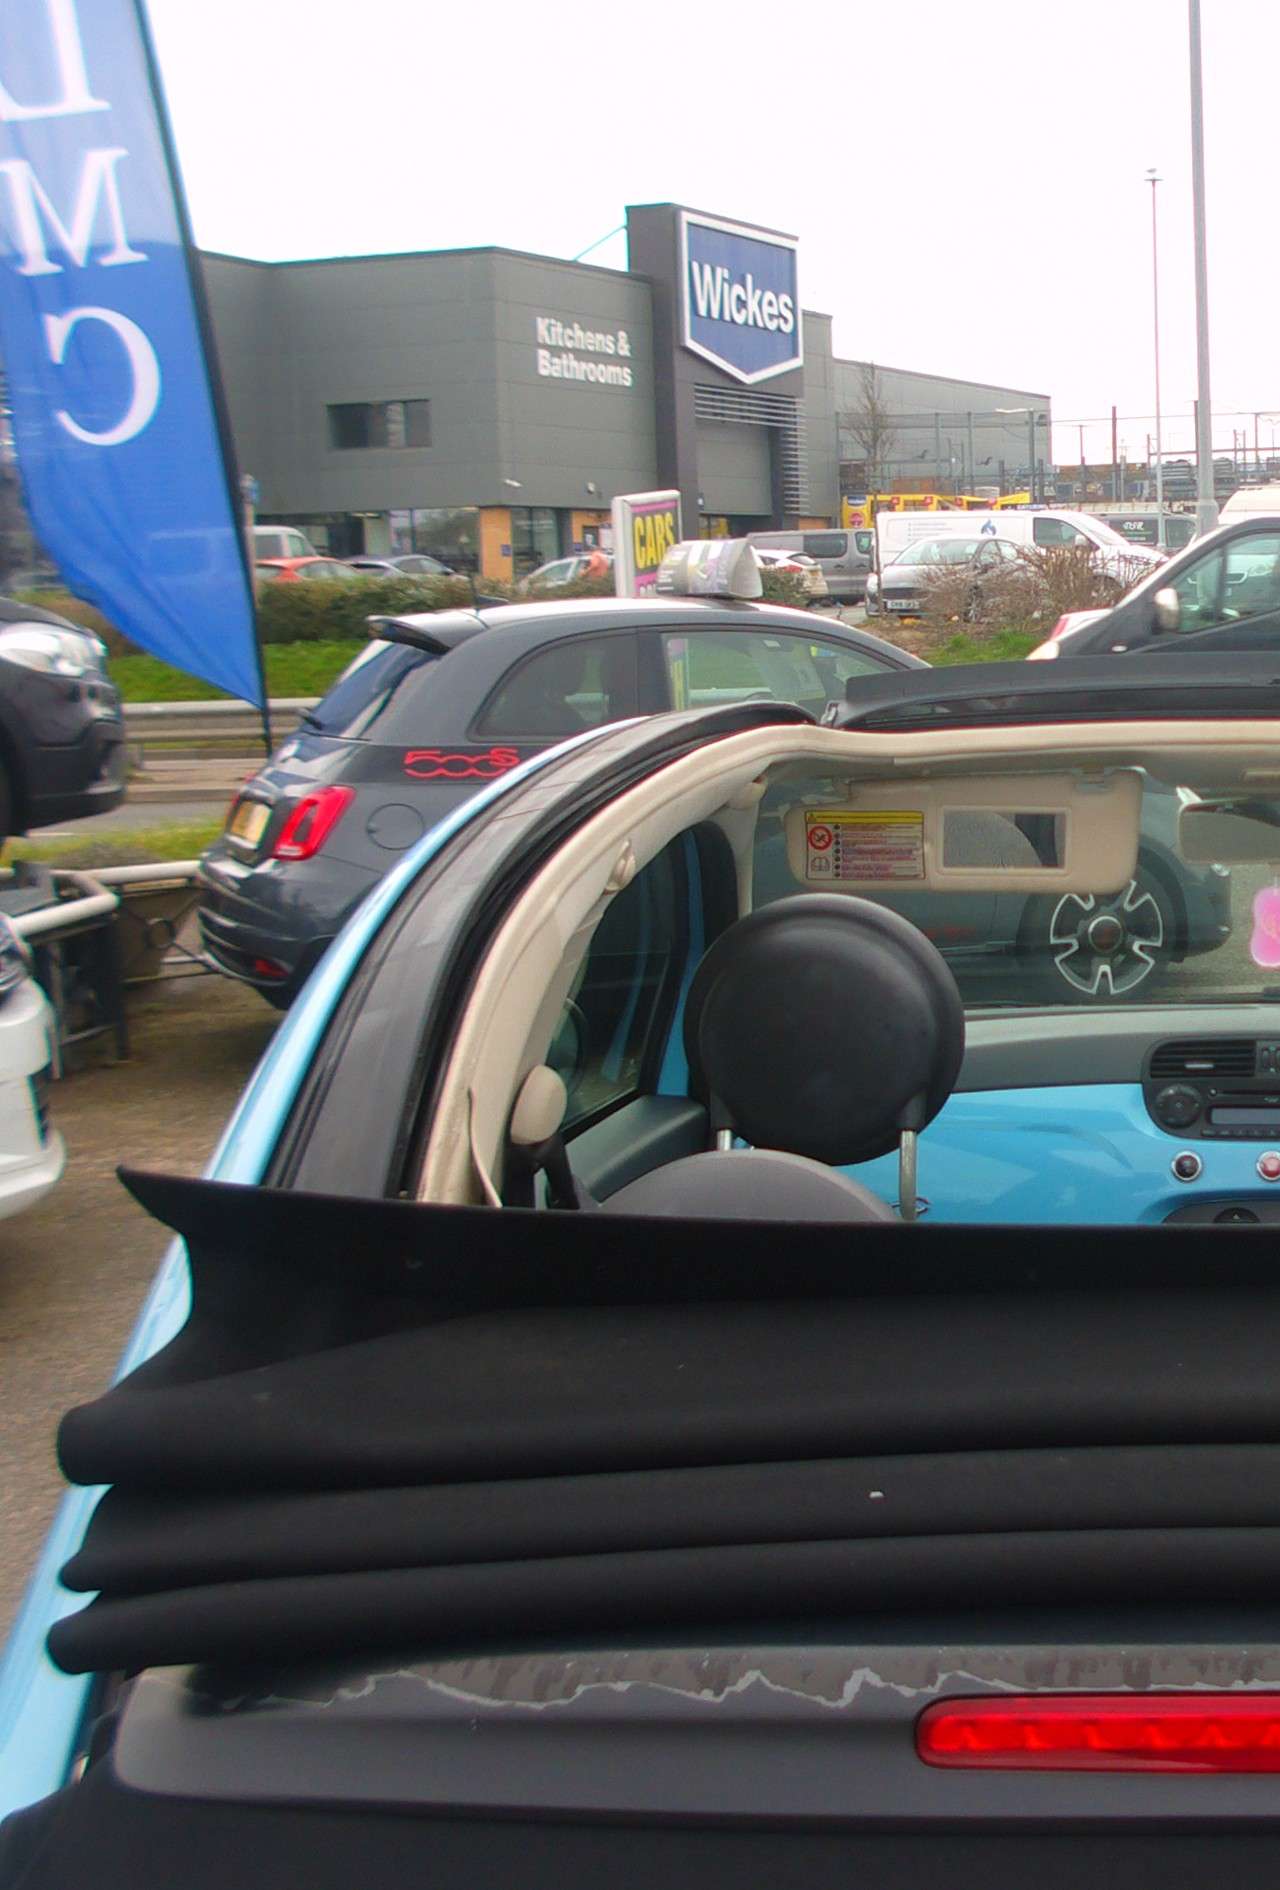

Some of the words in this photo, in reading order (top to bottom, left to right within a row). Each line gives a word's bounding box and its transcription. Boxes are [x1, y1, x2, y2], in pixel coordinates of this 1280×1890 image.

[691, 260, 795, 334] Wickes
[536, 316, 616, 355] Kitchens
[617, 330, 632, 357] &
[537, 348, 632, 387] Bathrooms
[633, 511, 675, 569] CARS
